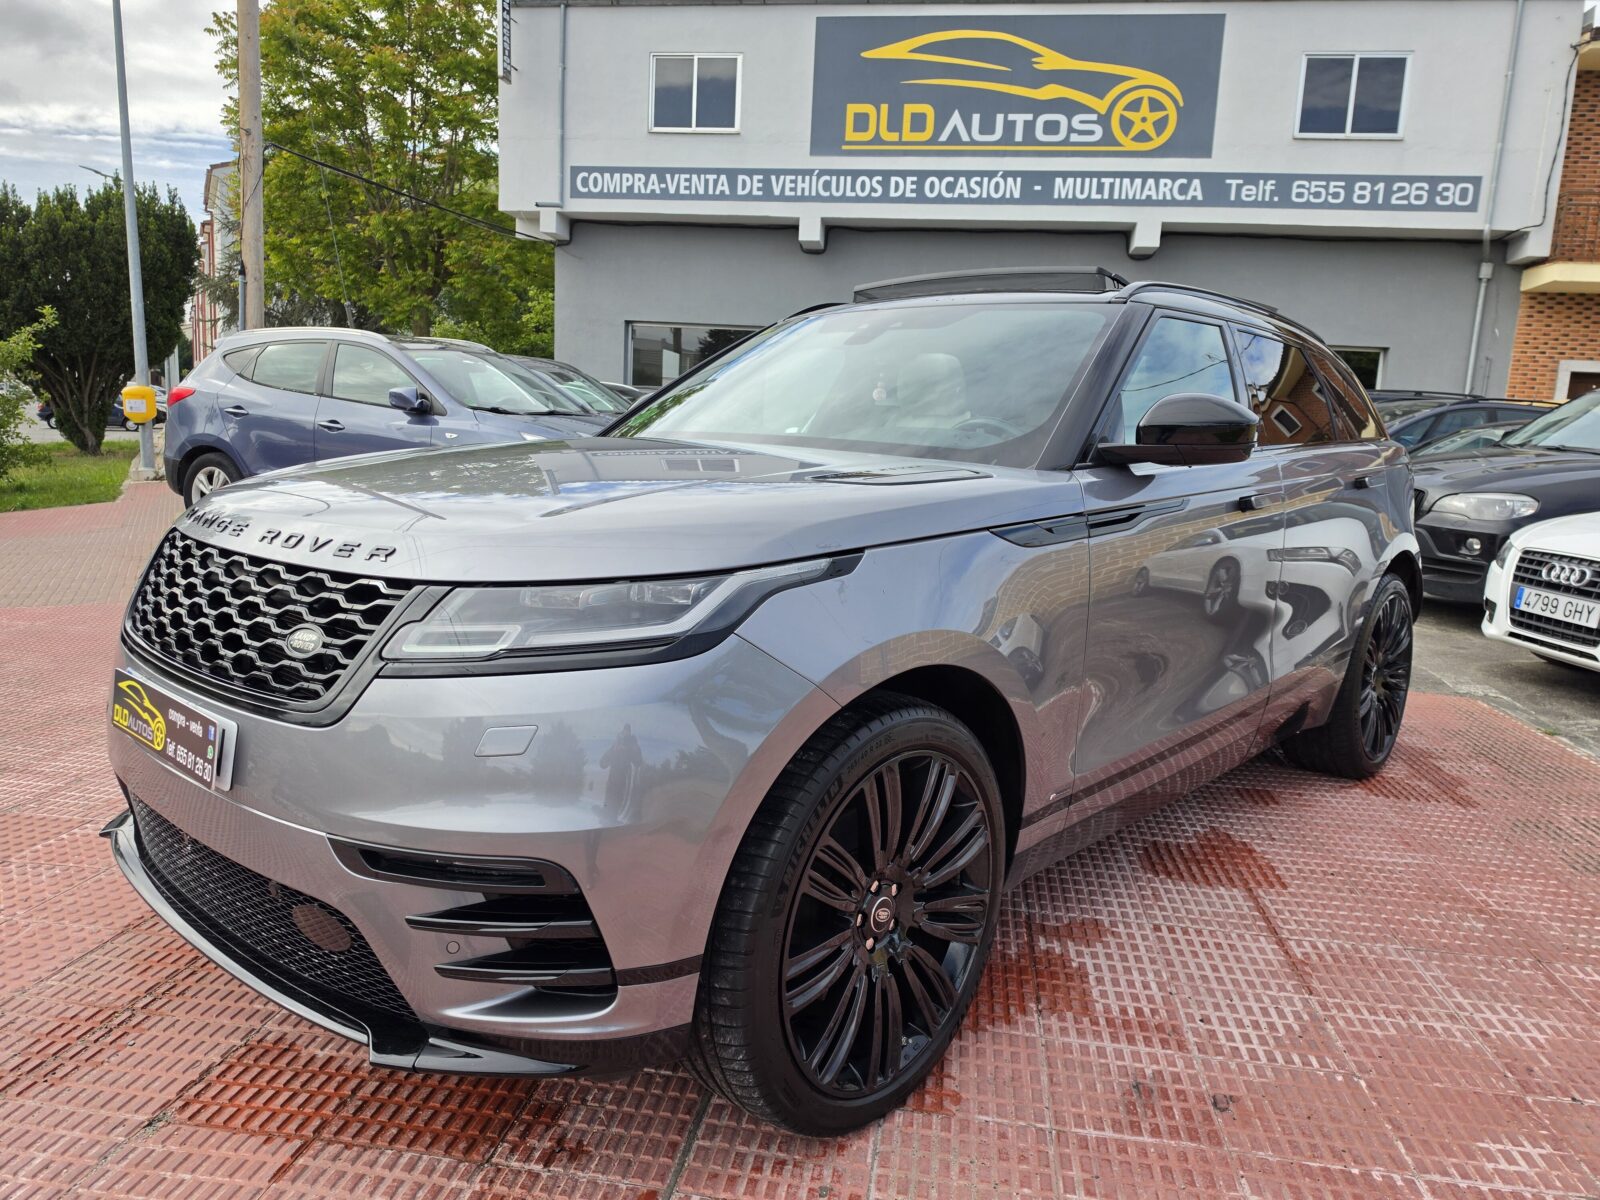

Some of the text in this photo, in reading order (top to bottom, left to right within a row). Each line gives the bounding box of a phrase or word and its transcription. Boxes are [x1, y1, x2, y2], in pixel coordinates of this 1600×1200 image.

[845, 103, 1103, 142] DLD AUTOS
[576, 172, 730, 195] COMPRA-VENTA
[737, 174, 763, 196] DE
[771, 169, 883, 198] VEHÍCULOS
[889, 175, 917, 198] DE
[924, 171, 1022, 199] OCASIÓN
[1053, 177, 1203, 200] MULTIMARCA
[1225, 179, 1279, 202] Telf.
[1291, 180, 1345, 204] 655
[1352, 181, 1385, 205] 81
[1390, 182, 1429, 206] 26
[1435, 182, 1475, 206] 30
[186, 507, 397, 563] RANGE ROVER
[1524, 591, 1596, 623] 4799 GHY
[113, 703, 153, 741] DLD AUTOS
[168, 708, 186, 729] compra
[189, 720, 203, 737] venta
[176, 745, 187, 765] 655
[187, 751, 195, 771] 81
[195, 757, 204, 776] 26
[203, 762, 212, 782] 30
[783, 773, 843, 887] MICHELIN
